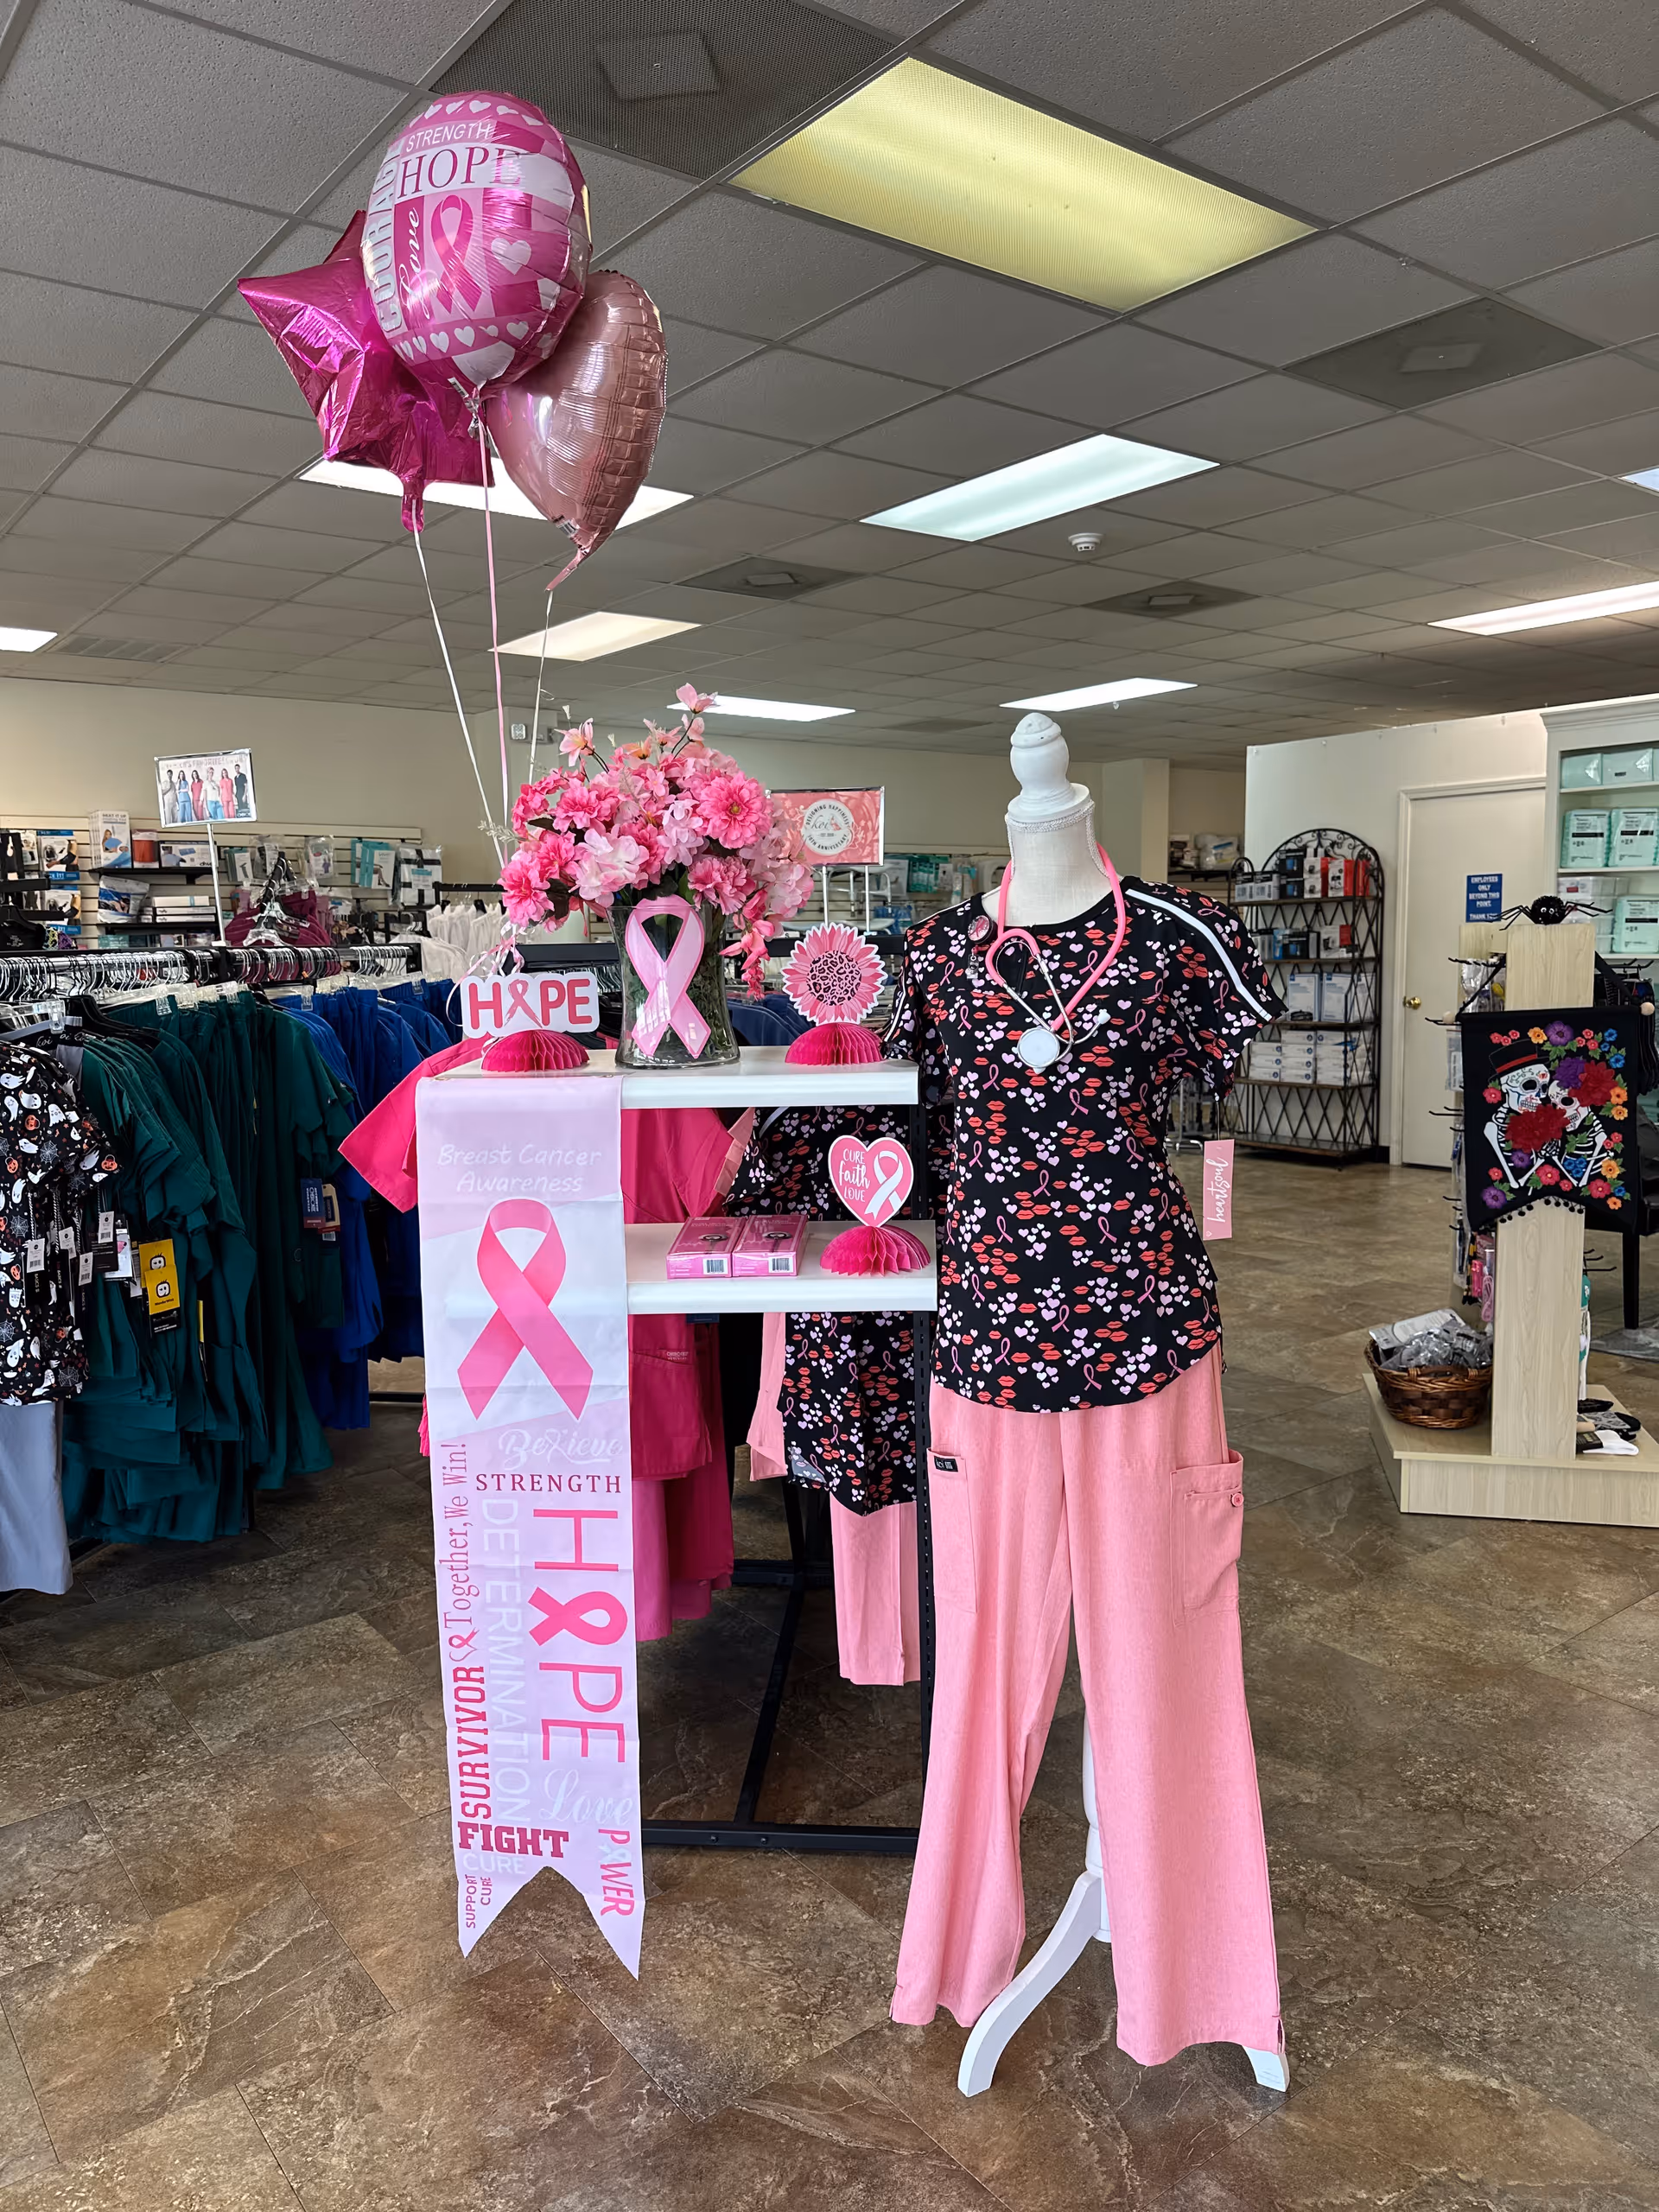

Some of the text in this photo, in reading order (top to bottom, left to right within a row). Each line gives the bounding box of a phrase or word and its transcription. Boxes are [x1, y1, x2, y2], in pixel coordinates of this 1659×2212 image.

[406, 122, 492, 152] STRENGTH
[397, 146, 521, 199] HOPE
[398, 207, 430, 320] Love
[805, 804, 849, 825] DESIGNING HAPPINESS
[811, 814, 830, 830] koi
[817, 834, 848, 850] ANNIVERSARY
[437, 1142, 602, 1166] Breast Cancer
[843, 1148, 866, 1165] CURE
[456, 1170, 584, 1193] Awareness
[843, 1186, 866, 1203] LOVE
[1206, 1156, 1230, 1223] heartsoul
[476, 1473, 621, 1494] STRENGTH
[439, 1443, 480, 1629] Together, We Win!
[481, 1498, 531, 1823] DETERMINATION
[453, 1666, 492, 1820] SURVIVOR
[539, 1768, 633, 1826] Love
[458, 1821, 569, 1859] FIGHT
[462, 1852, 527, 1875] CURE
[466, 1874, 476, 1929] SUPPORT
[480, 1877, 492, 1906] CURE
